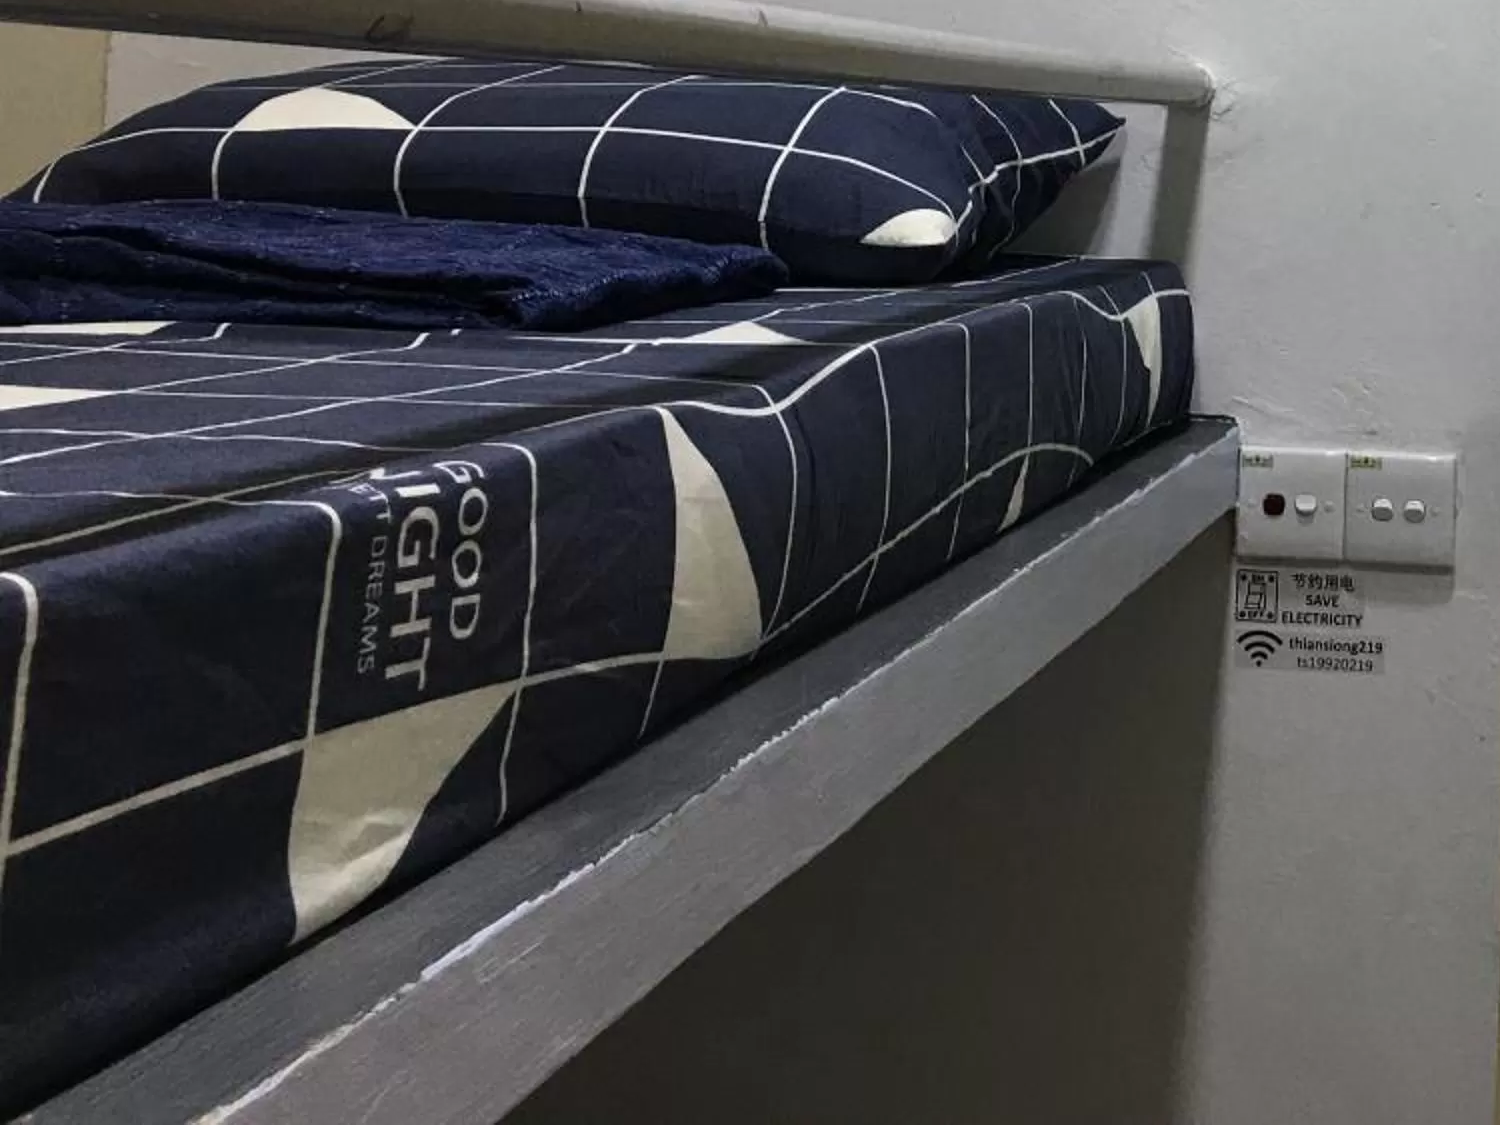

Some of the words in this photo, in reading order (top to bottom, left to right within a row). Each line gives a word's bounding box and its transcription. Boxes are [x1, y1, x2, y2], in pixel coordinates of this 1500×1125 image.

[432, 460, 488, 640] GOOD
[1292, 573, 1356, 592] 节约用电
[357, 535, 389, 675] DREAMS
[1305, 594, 1340, 608] SAVE
[1281, 611, 1363, 628] ELECTRICITY
